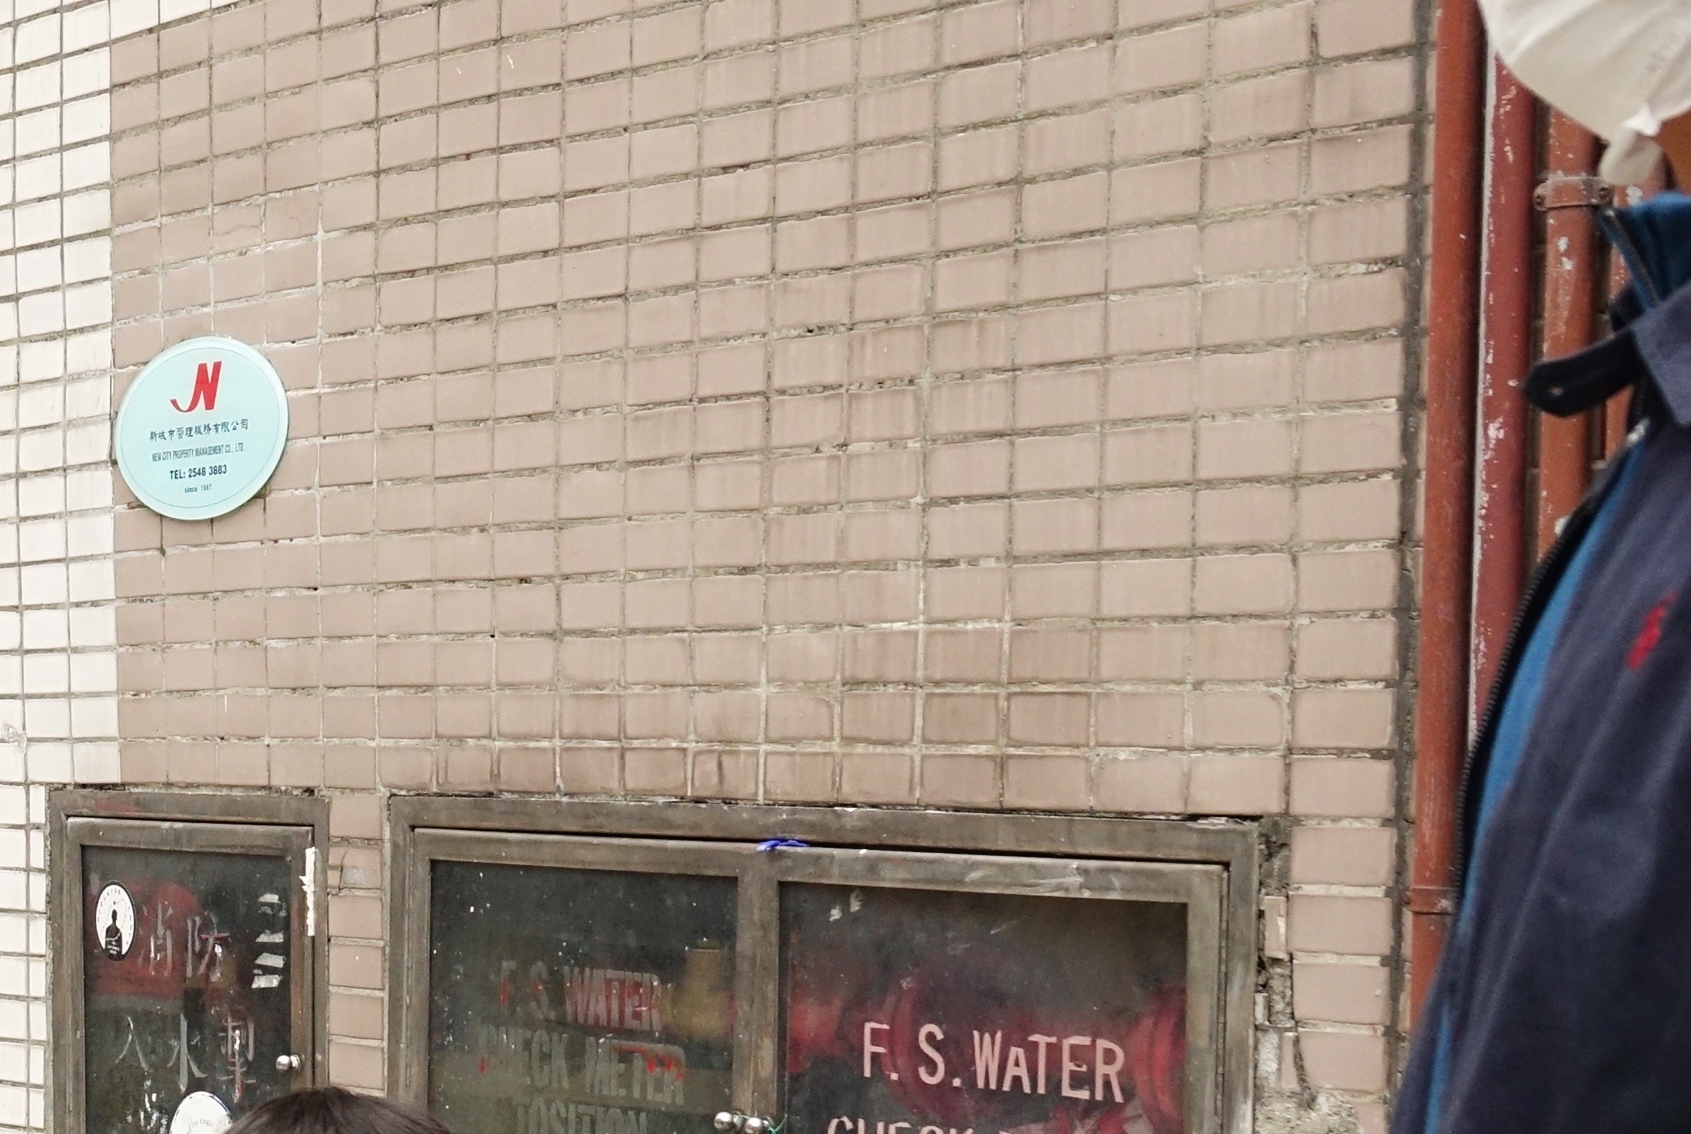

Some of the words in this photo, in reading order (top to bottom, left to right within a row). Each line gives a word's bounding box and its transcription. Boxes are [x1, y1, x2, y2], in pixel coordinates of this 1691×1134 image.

[152, 452, 162, 462] NEW
[162, 451, 172, 461] CITY
[173, 448, 195, 459] PROPERTY
[195, 444, 225, 457] MANAGEMENT
[169, 469, 186, 480] TEL:
[863, 1021, 900, 1081] F.
[917, 1023, 963, 1088] S.
[972, 1029, 1126, 1104] WATER
